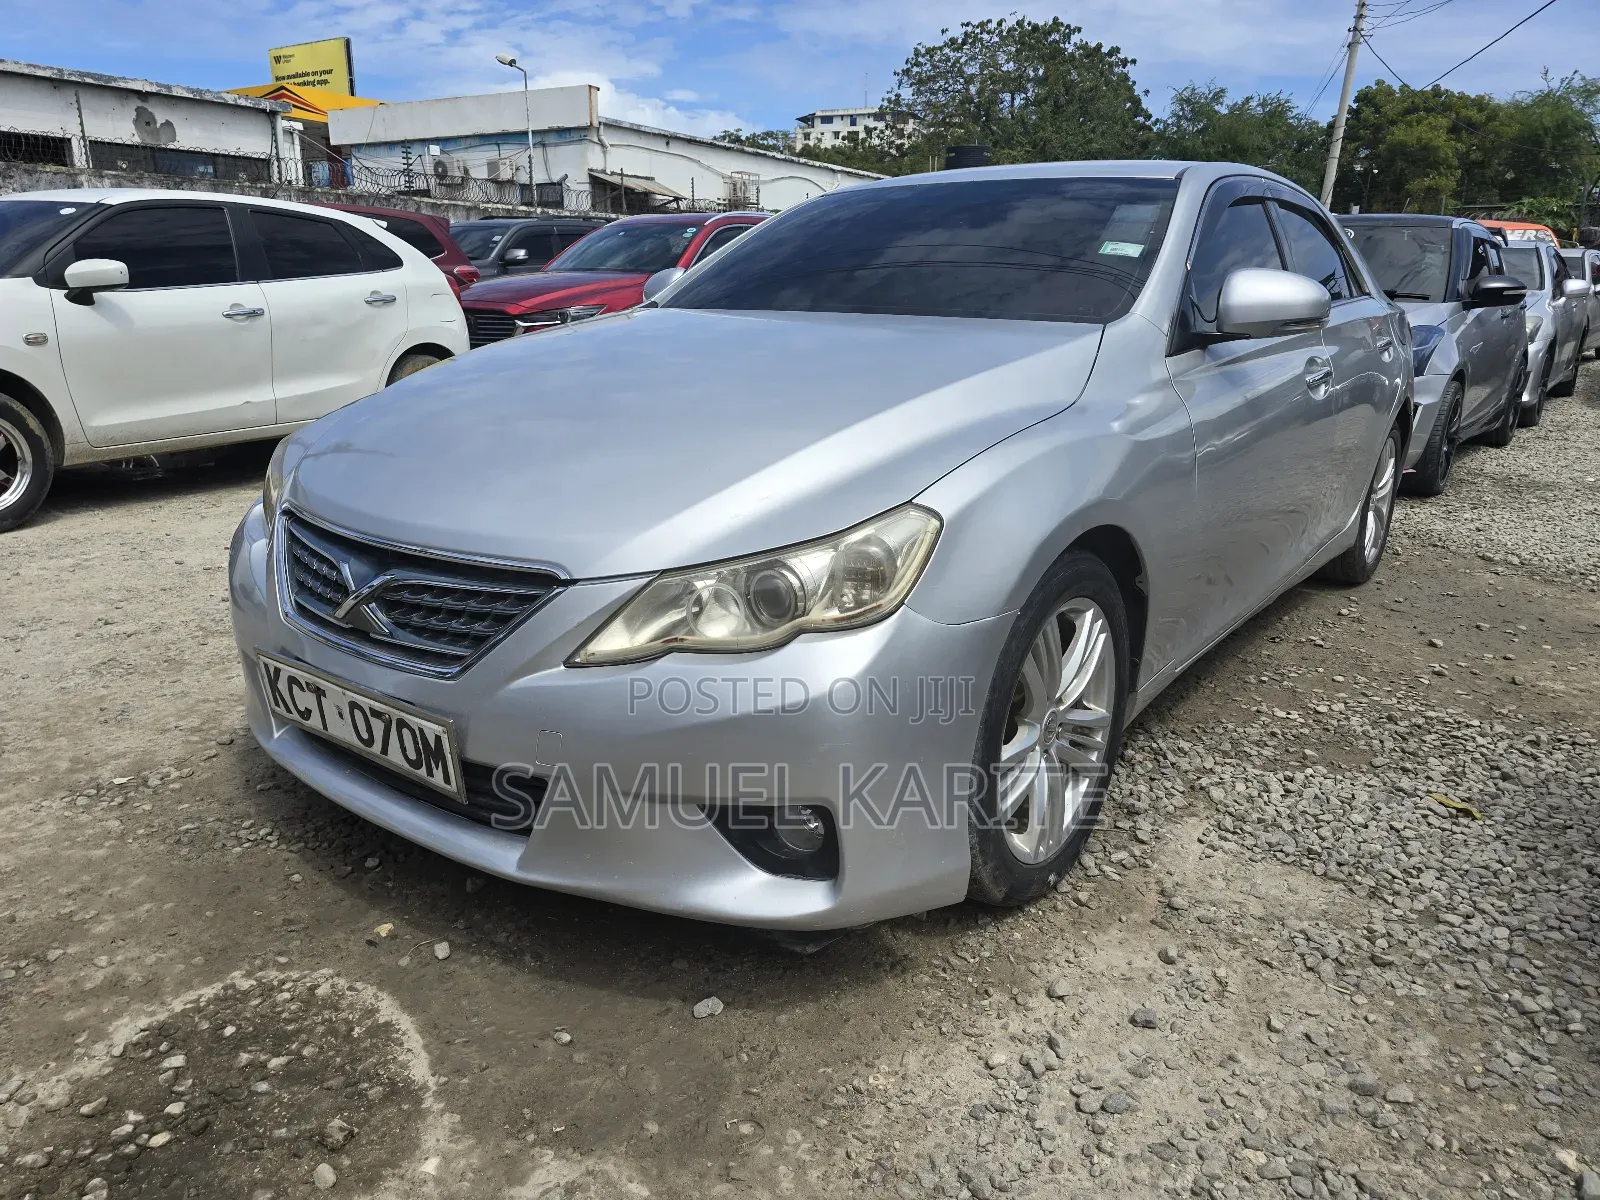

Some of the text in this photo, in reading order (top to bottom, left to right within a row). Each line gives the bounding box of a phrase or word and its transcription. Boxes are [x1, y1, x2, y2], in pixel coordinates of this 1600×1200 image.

[286, 71, 310, 80] available
[319, 69, 334, 77] your
[263, 661, 452, 786] KCT 070M
